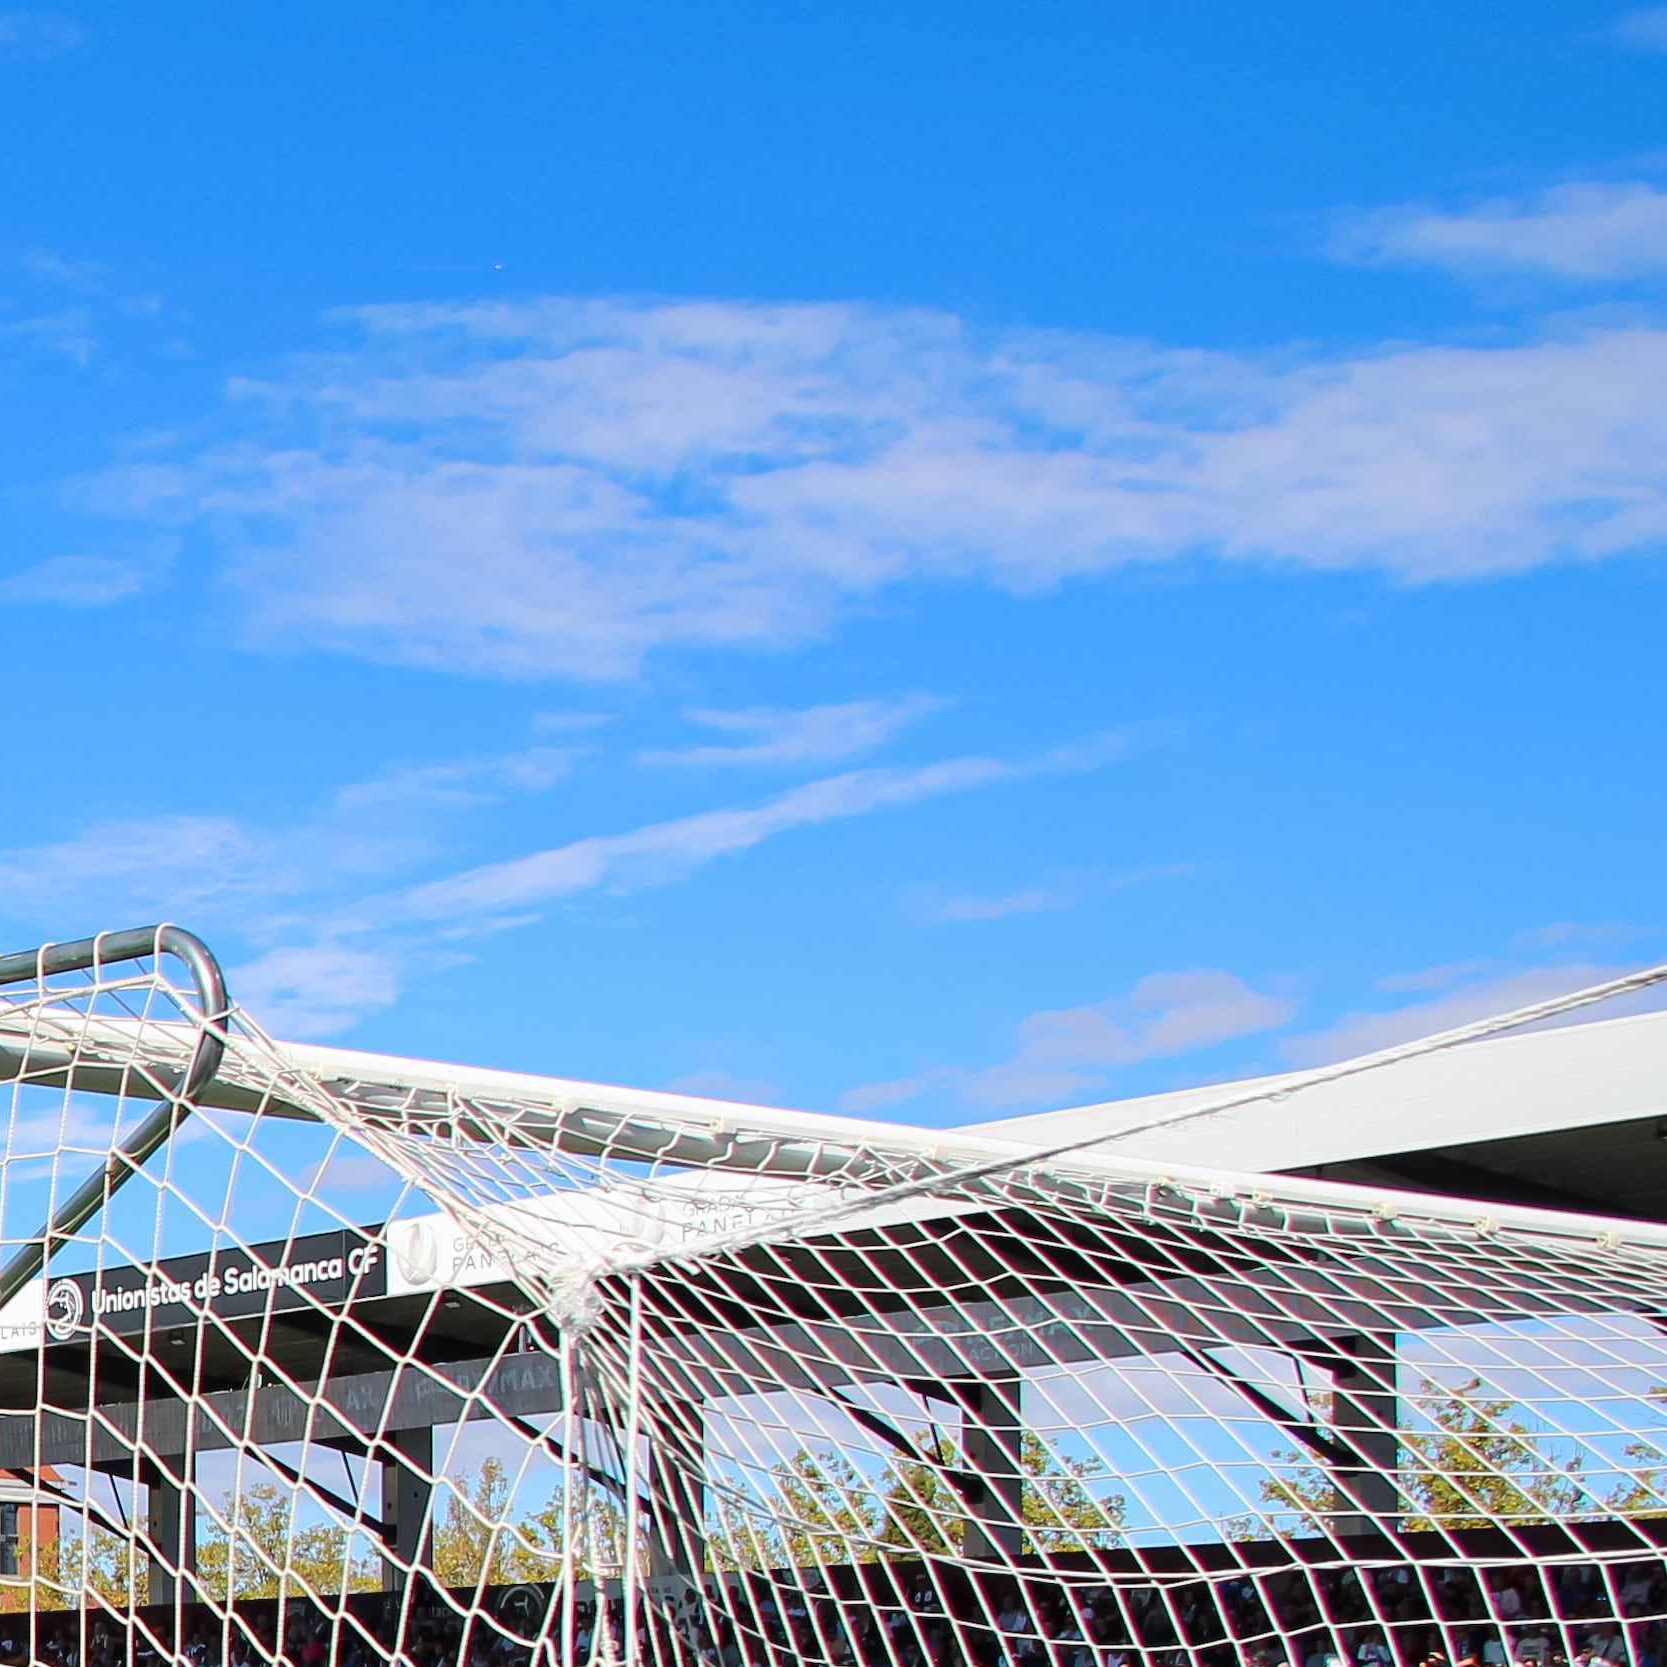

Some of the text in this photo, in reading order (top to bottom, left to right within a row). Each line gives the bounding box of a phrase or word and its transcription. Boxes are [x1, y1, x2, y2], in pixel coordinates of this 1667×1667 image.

[92, 1246, 379, 1314] Unionistas de Salamanca CF
